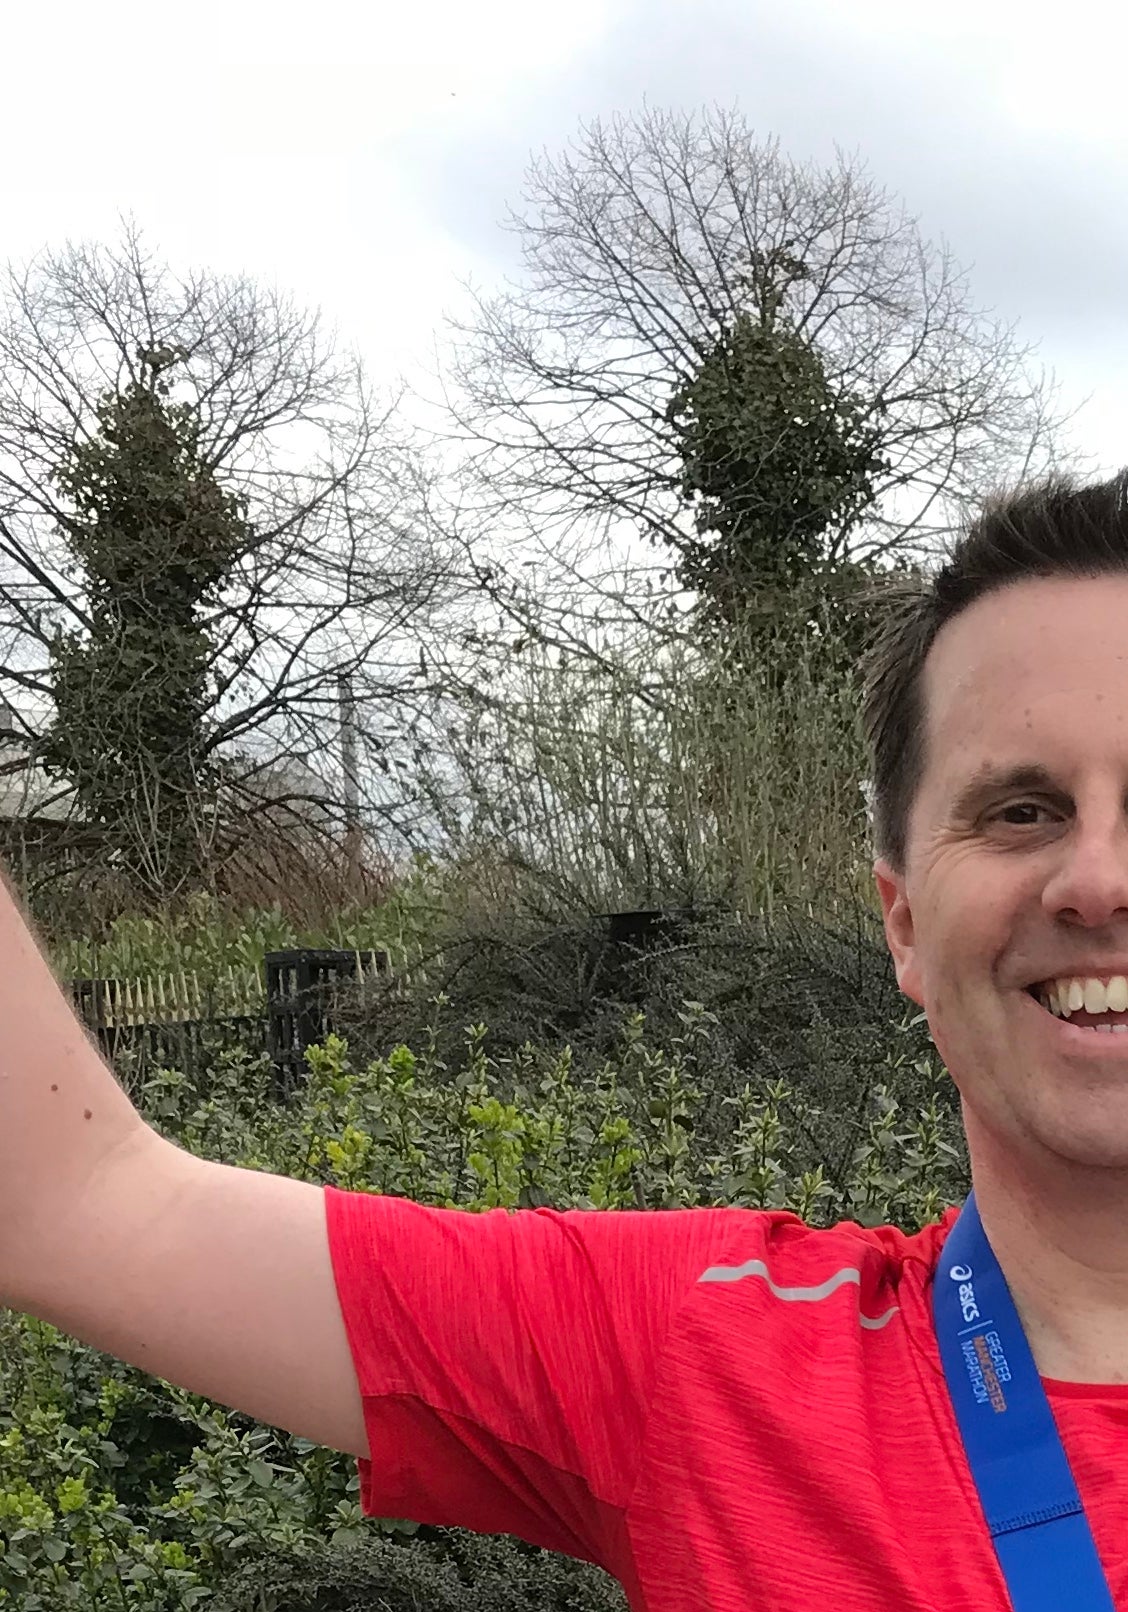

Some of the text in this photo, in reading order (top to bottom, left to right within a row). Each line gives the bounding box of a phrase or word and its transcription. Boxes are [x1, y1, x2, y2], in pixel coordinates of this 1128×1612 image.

[958, 1282, 980, 1323] asics
[960, 1339, 989, 1404] MARATHON
[984, 1330, 1012, 1383] GREATER
